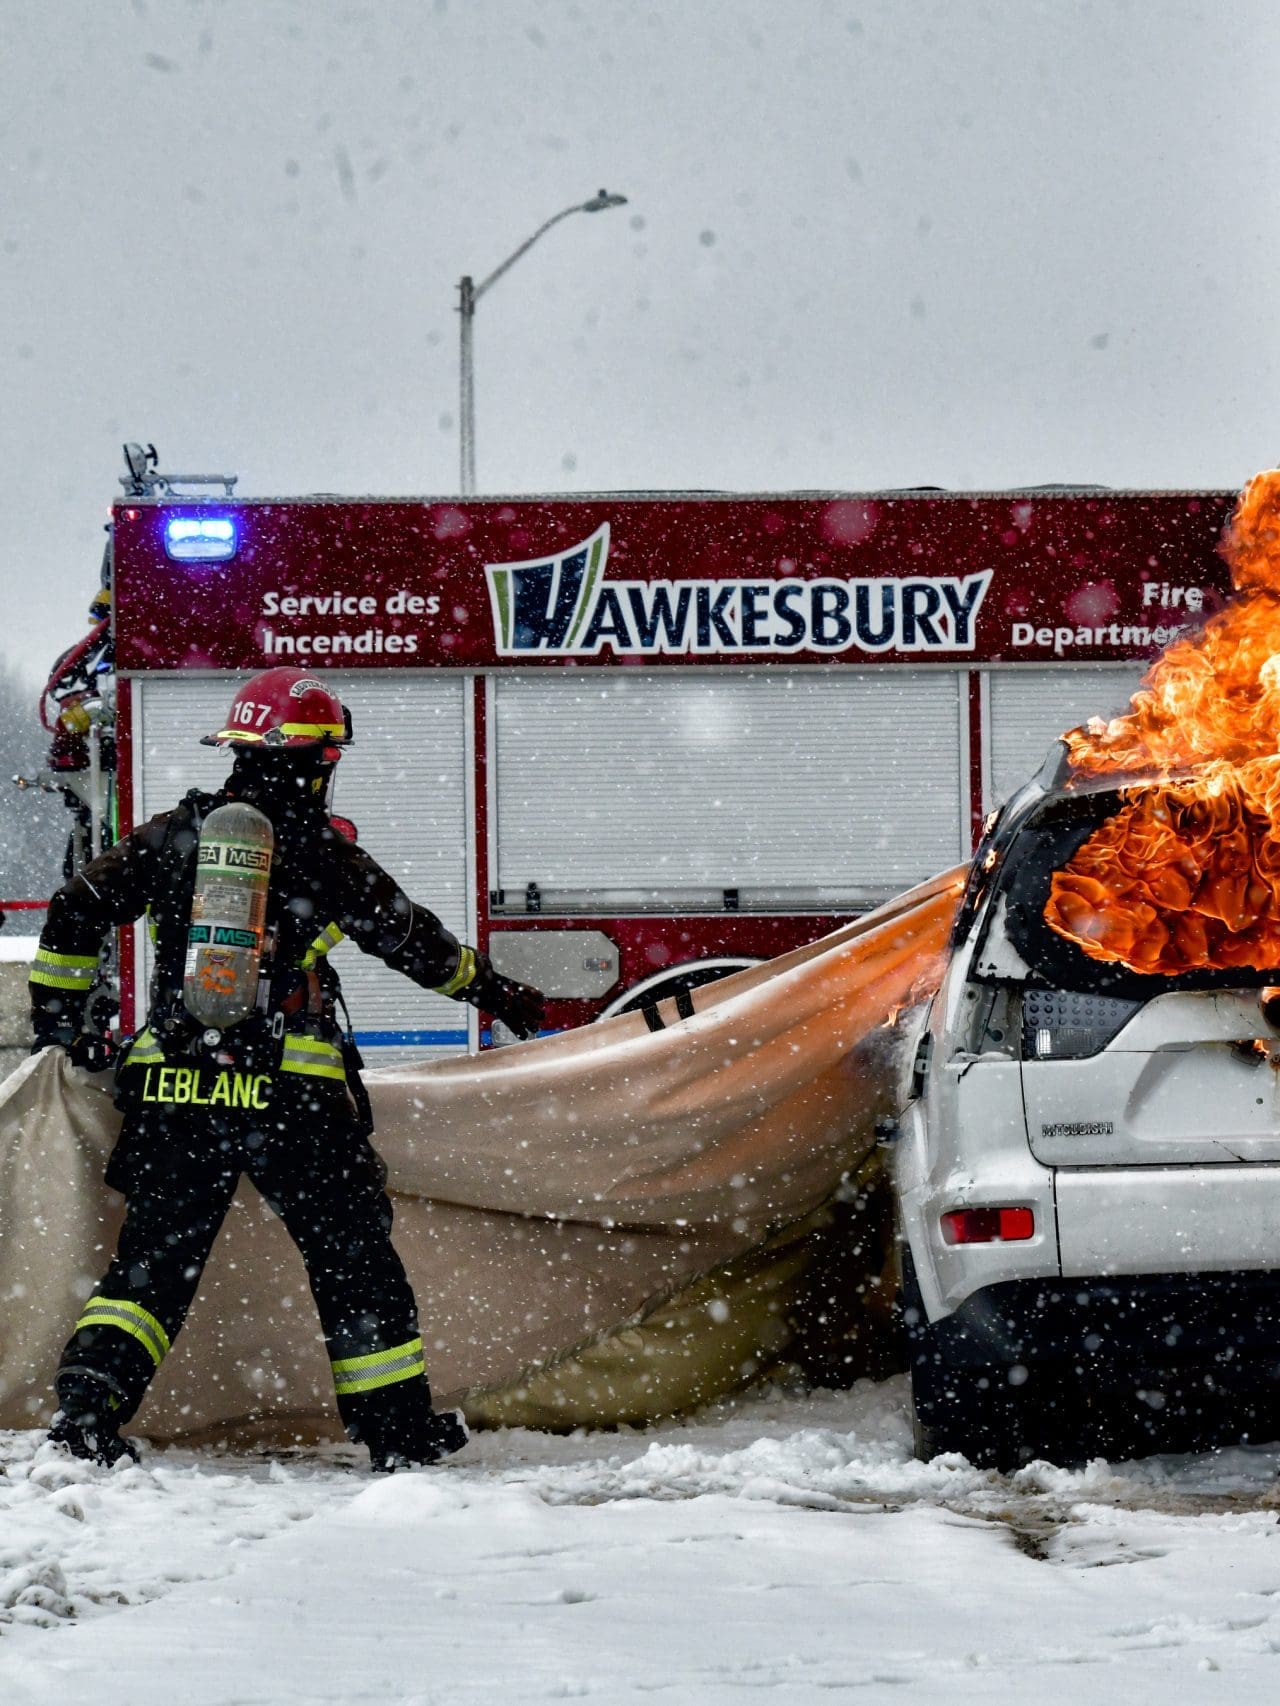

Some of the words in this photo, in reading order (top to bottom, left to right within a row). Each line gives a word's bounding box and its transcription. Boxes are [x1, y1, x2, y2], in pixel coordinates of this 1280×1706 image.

[488, 523, 993, 653] HAWKESBURY
[1142, 582, 1203, 611] Fire
[262, 591, 377, 616] Service
[385, 591, 440, 615] des
[263, 630, 418, 654] Incendies
[233, 701, 271, 727] 167
[228, 850, 268, 869] MSA
[142, 1067, 272, 1110] LEBLANC
[1041, 1122, 1113, 1136] MITSUBISHI
